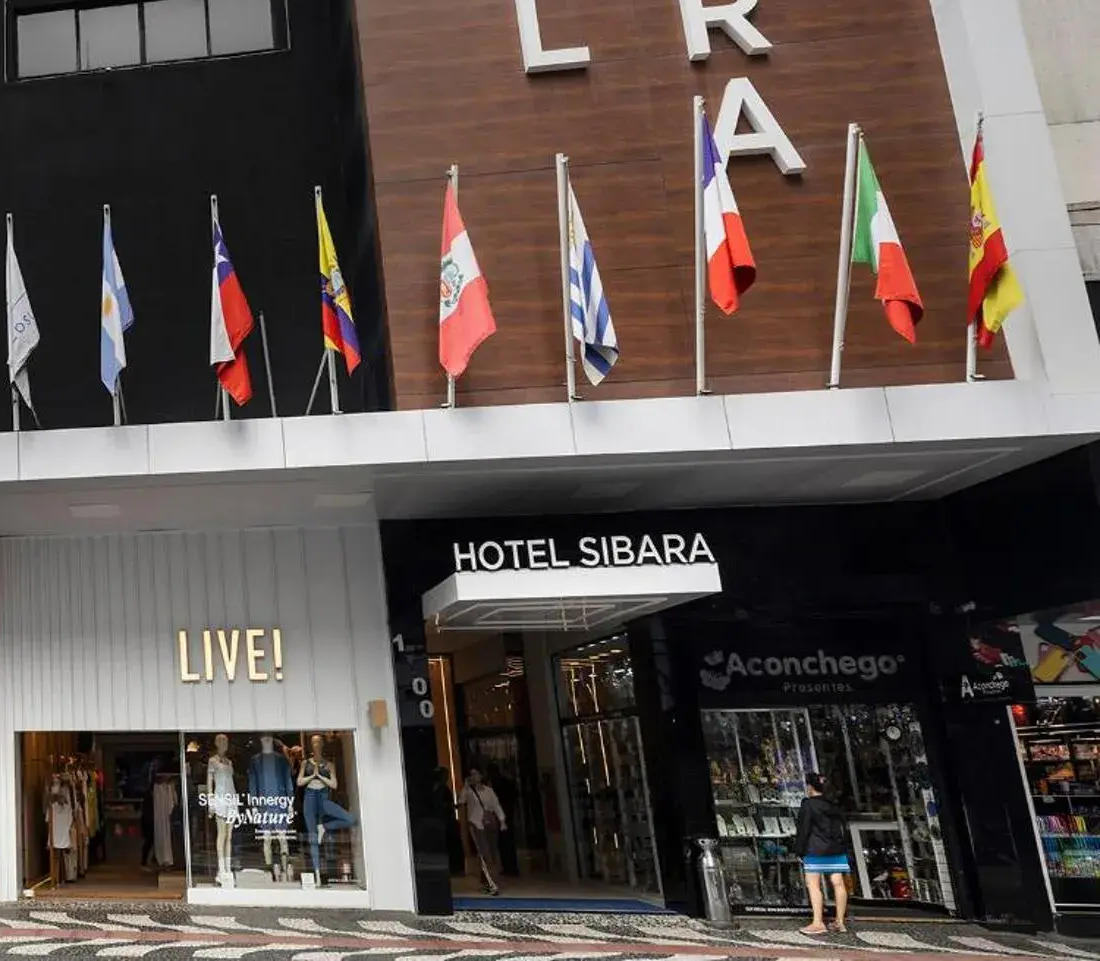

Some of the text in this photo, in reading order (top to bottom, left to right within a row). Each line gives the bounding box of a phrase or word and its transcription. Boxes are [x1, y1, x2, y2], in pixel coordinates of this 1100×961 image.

[453, 533, 716, 571] HOTEL SIBARA
[178, 629, 284, 681] LIVE!
[726, 649, 899, 681] Aconchego
[247, 793, 295, 808] Innergy
